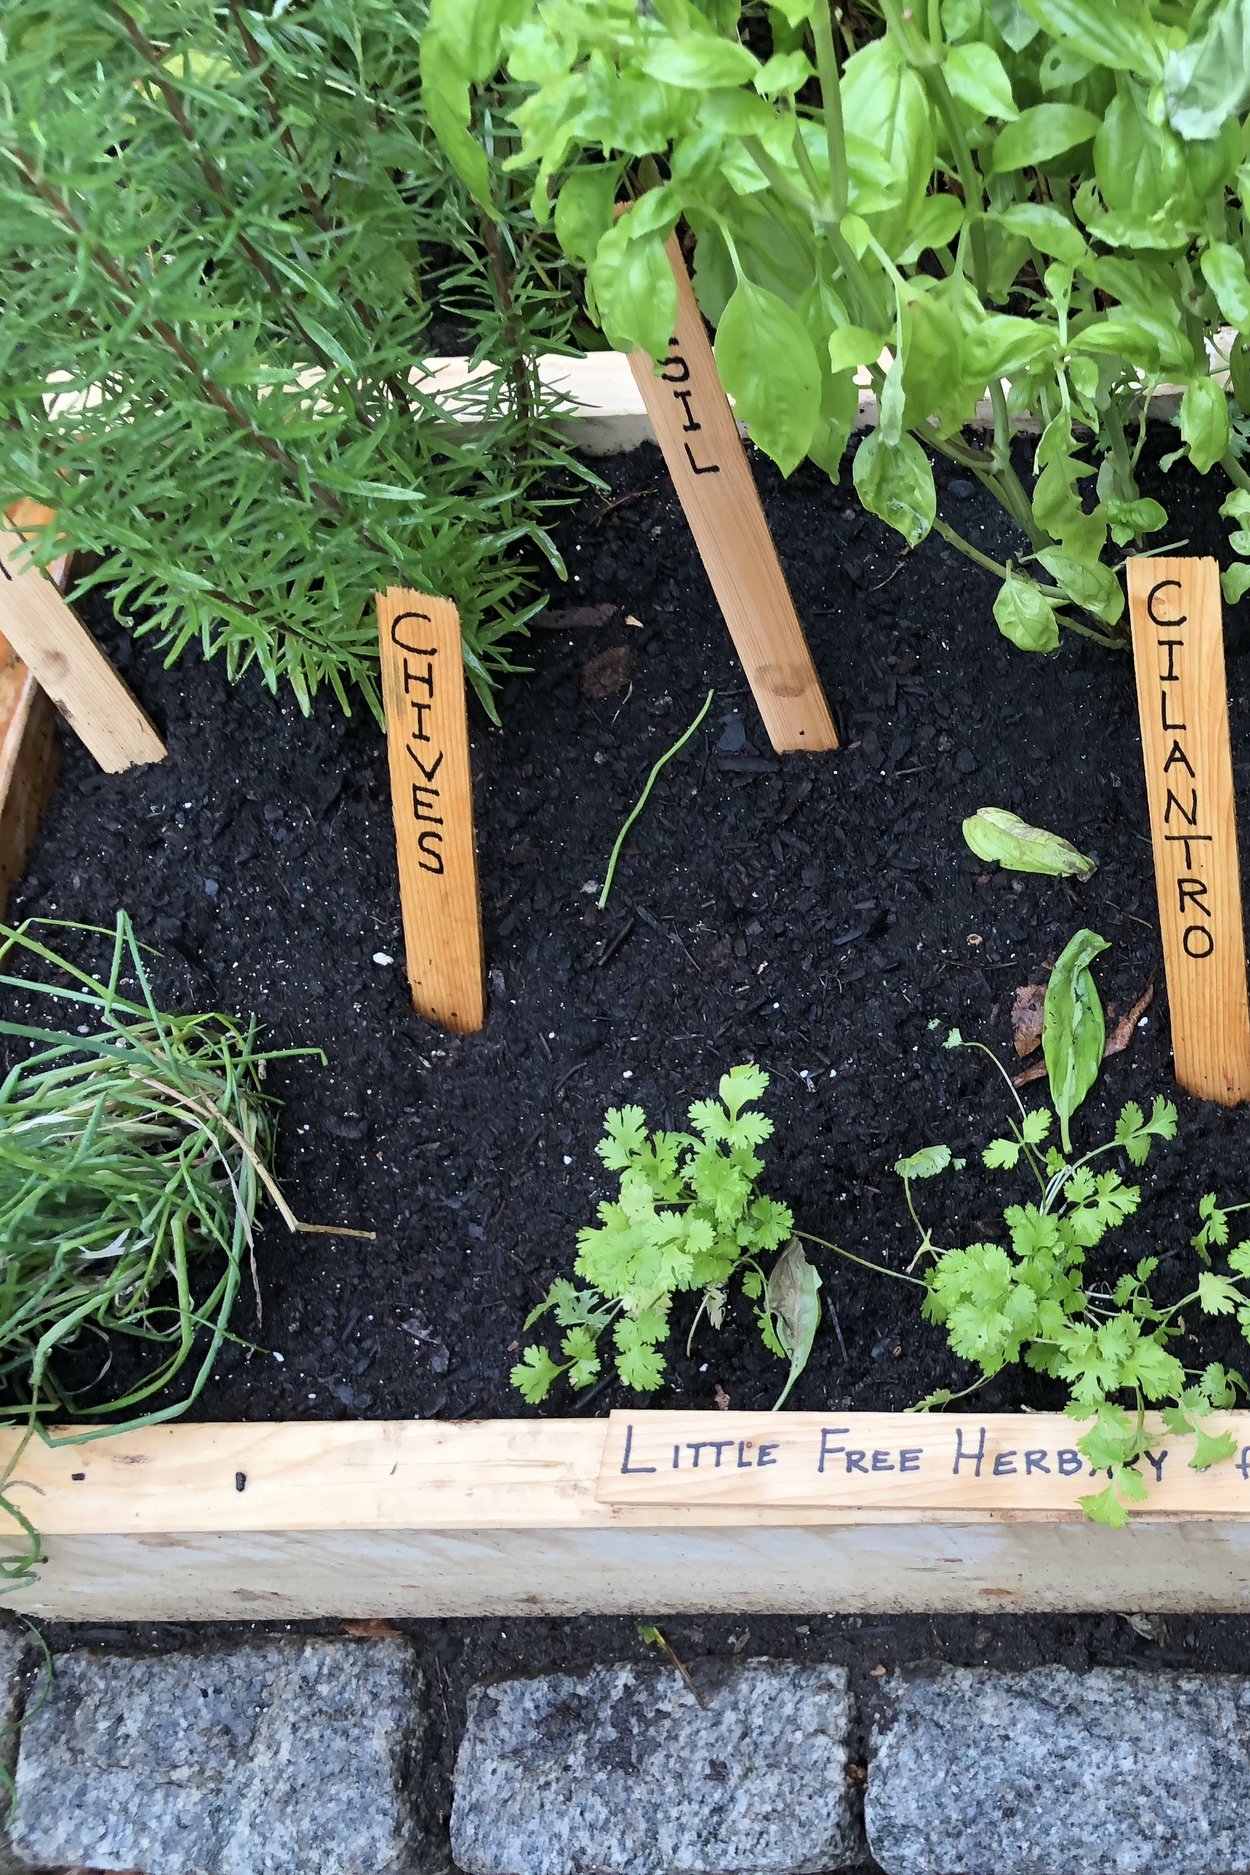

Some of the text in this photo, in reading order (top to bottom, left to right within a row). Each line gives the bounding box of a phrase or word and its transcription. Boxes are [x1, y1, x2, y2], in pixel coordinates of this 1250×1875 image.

[656, 335, 721, 475] SIL
[390, 611, 445, 876] CHIVES
[1146, 579, 1215, 960] CILANTRO
[620, 1424, 780, 1474] LITTLE
[817, 1427, 924, 1474] FREE
[952, 1426, 1169, 1483] HERBY
